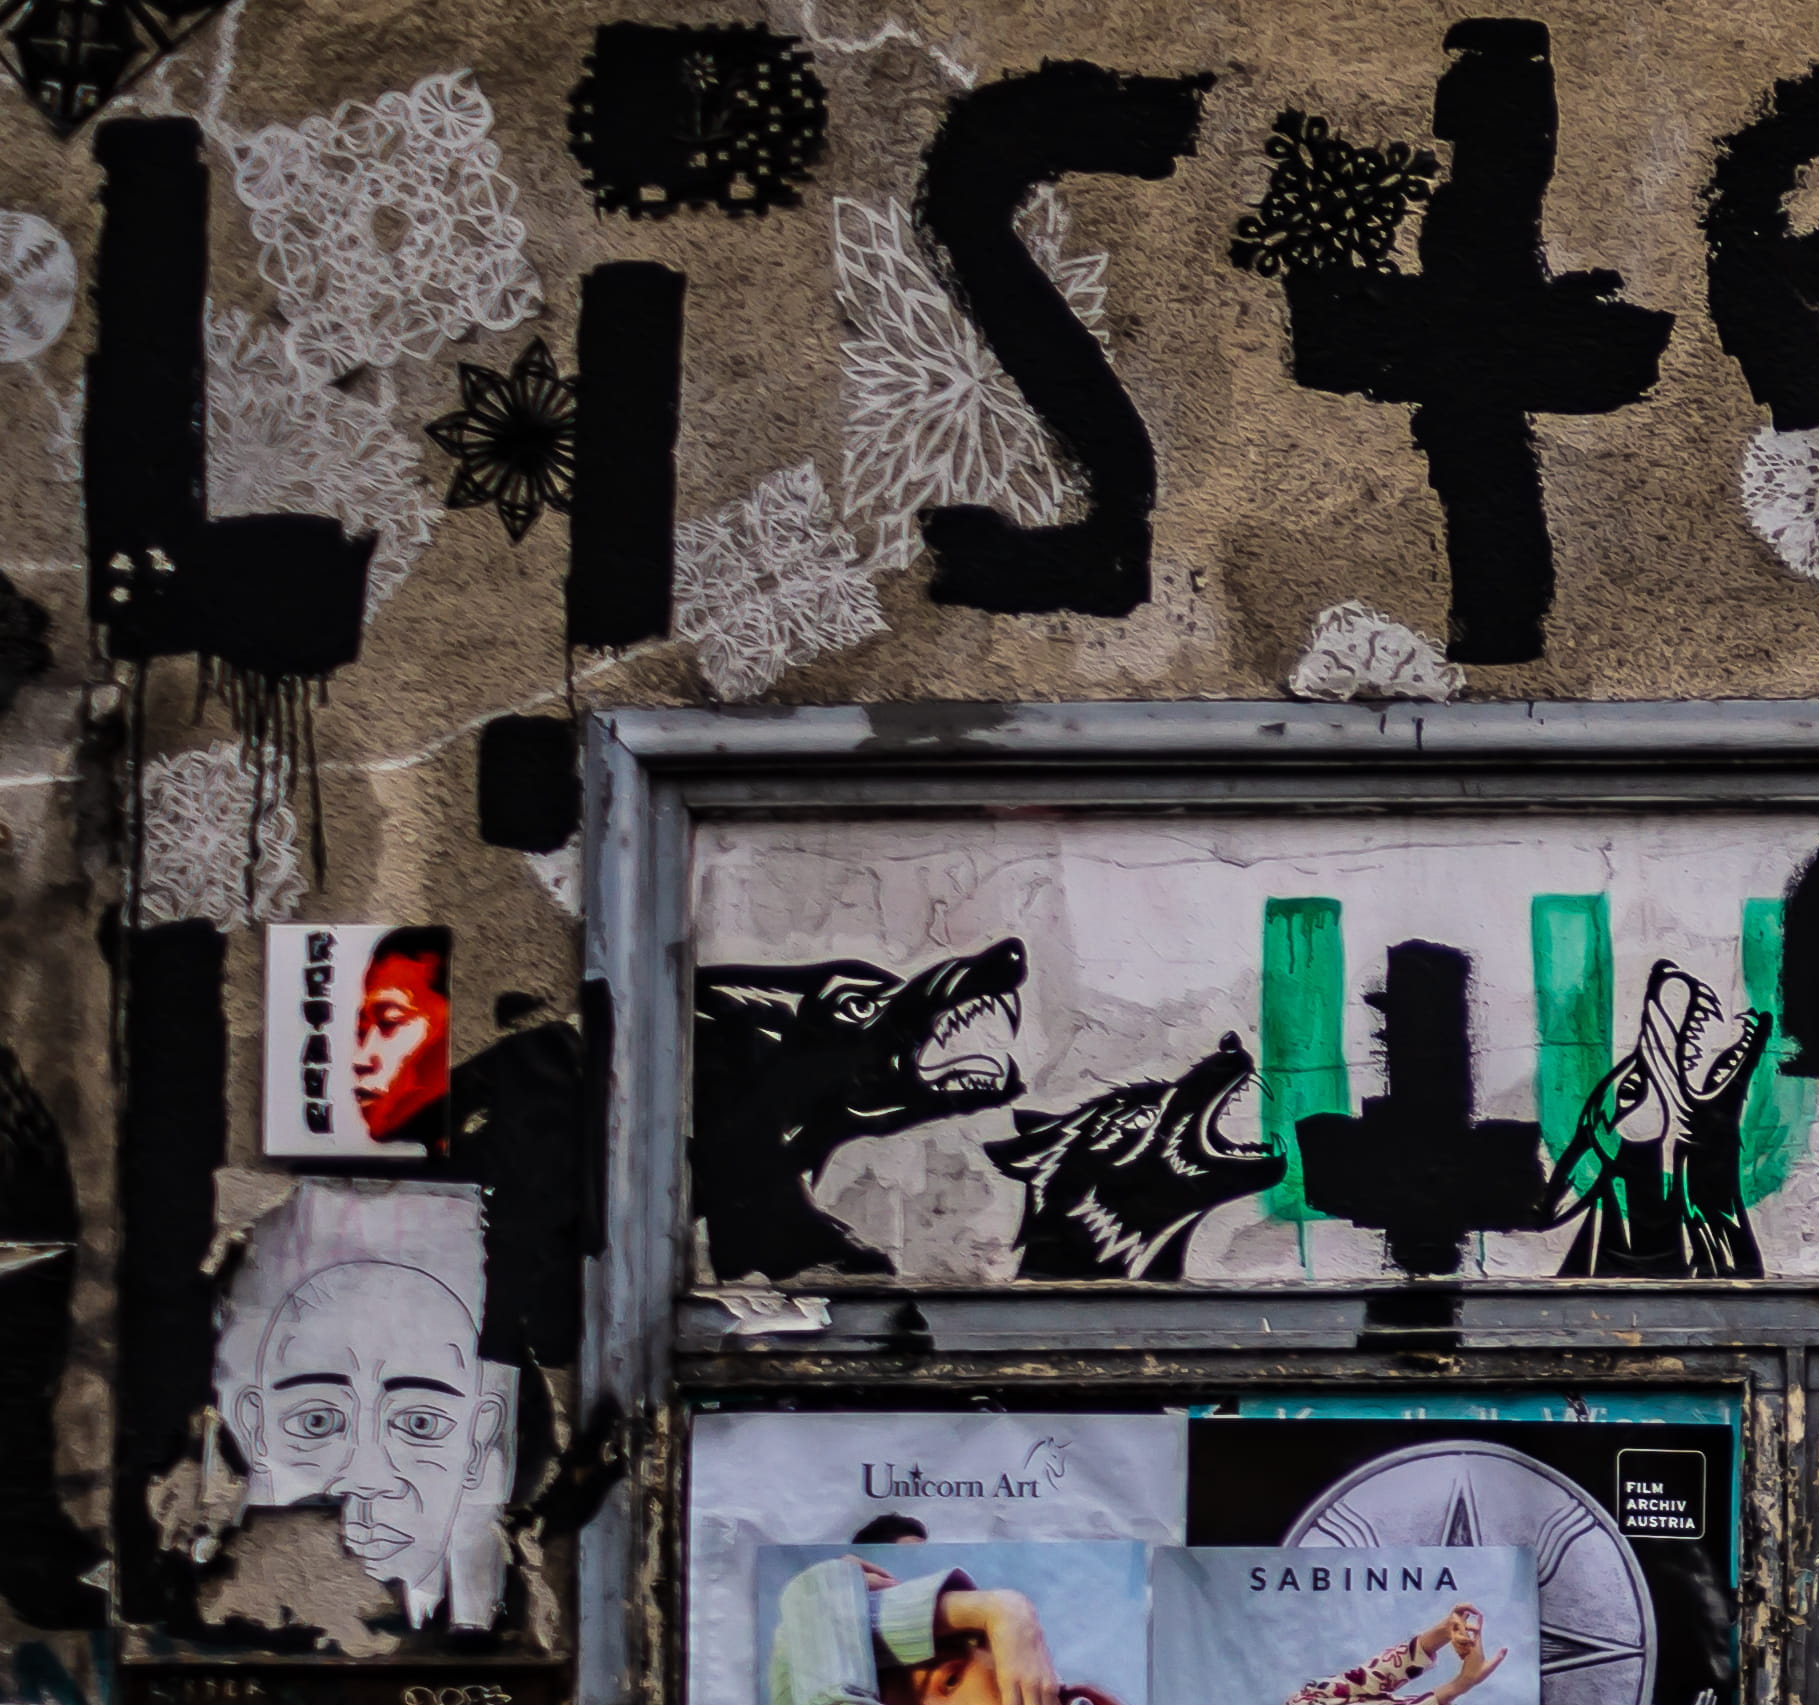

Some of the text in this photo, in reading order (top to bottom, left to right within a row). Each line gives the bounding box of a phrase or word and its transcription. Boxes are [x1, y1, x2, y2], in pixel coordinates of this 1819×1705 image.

[862, 1462, 1040, 1499] Unicorn Art
[1626, 1481, 1664, 1494] FILM
[1626, 1498, 1687, 1511] ARCHIV
[1626, 1515, 1696, 1529] AUSTRIA
[1249, 1566, 1459, 1592] SABINNA
